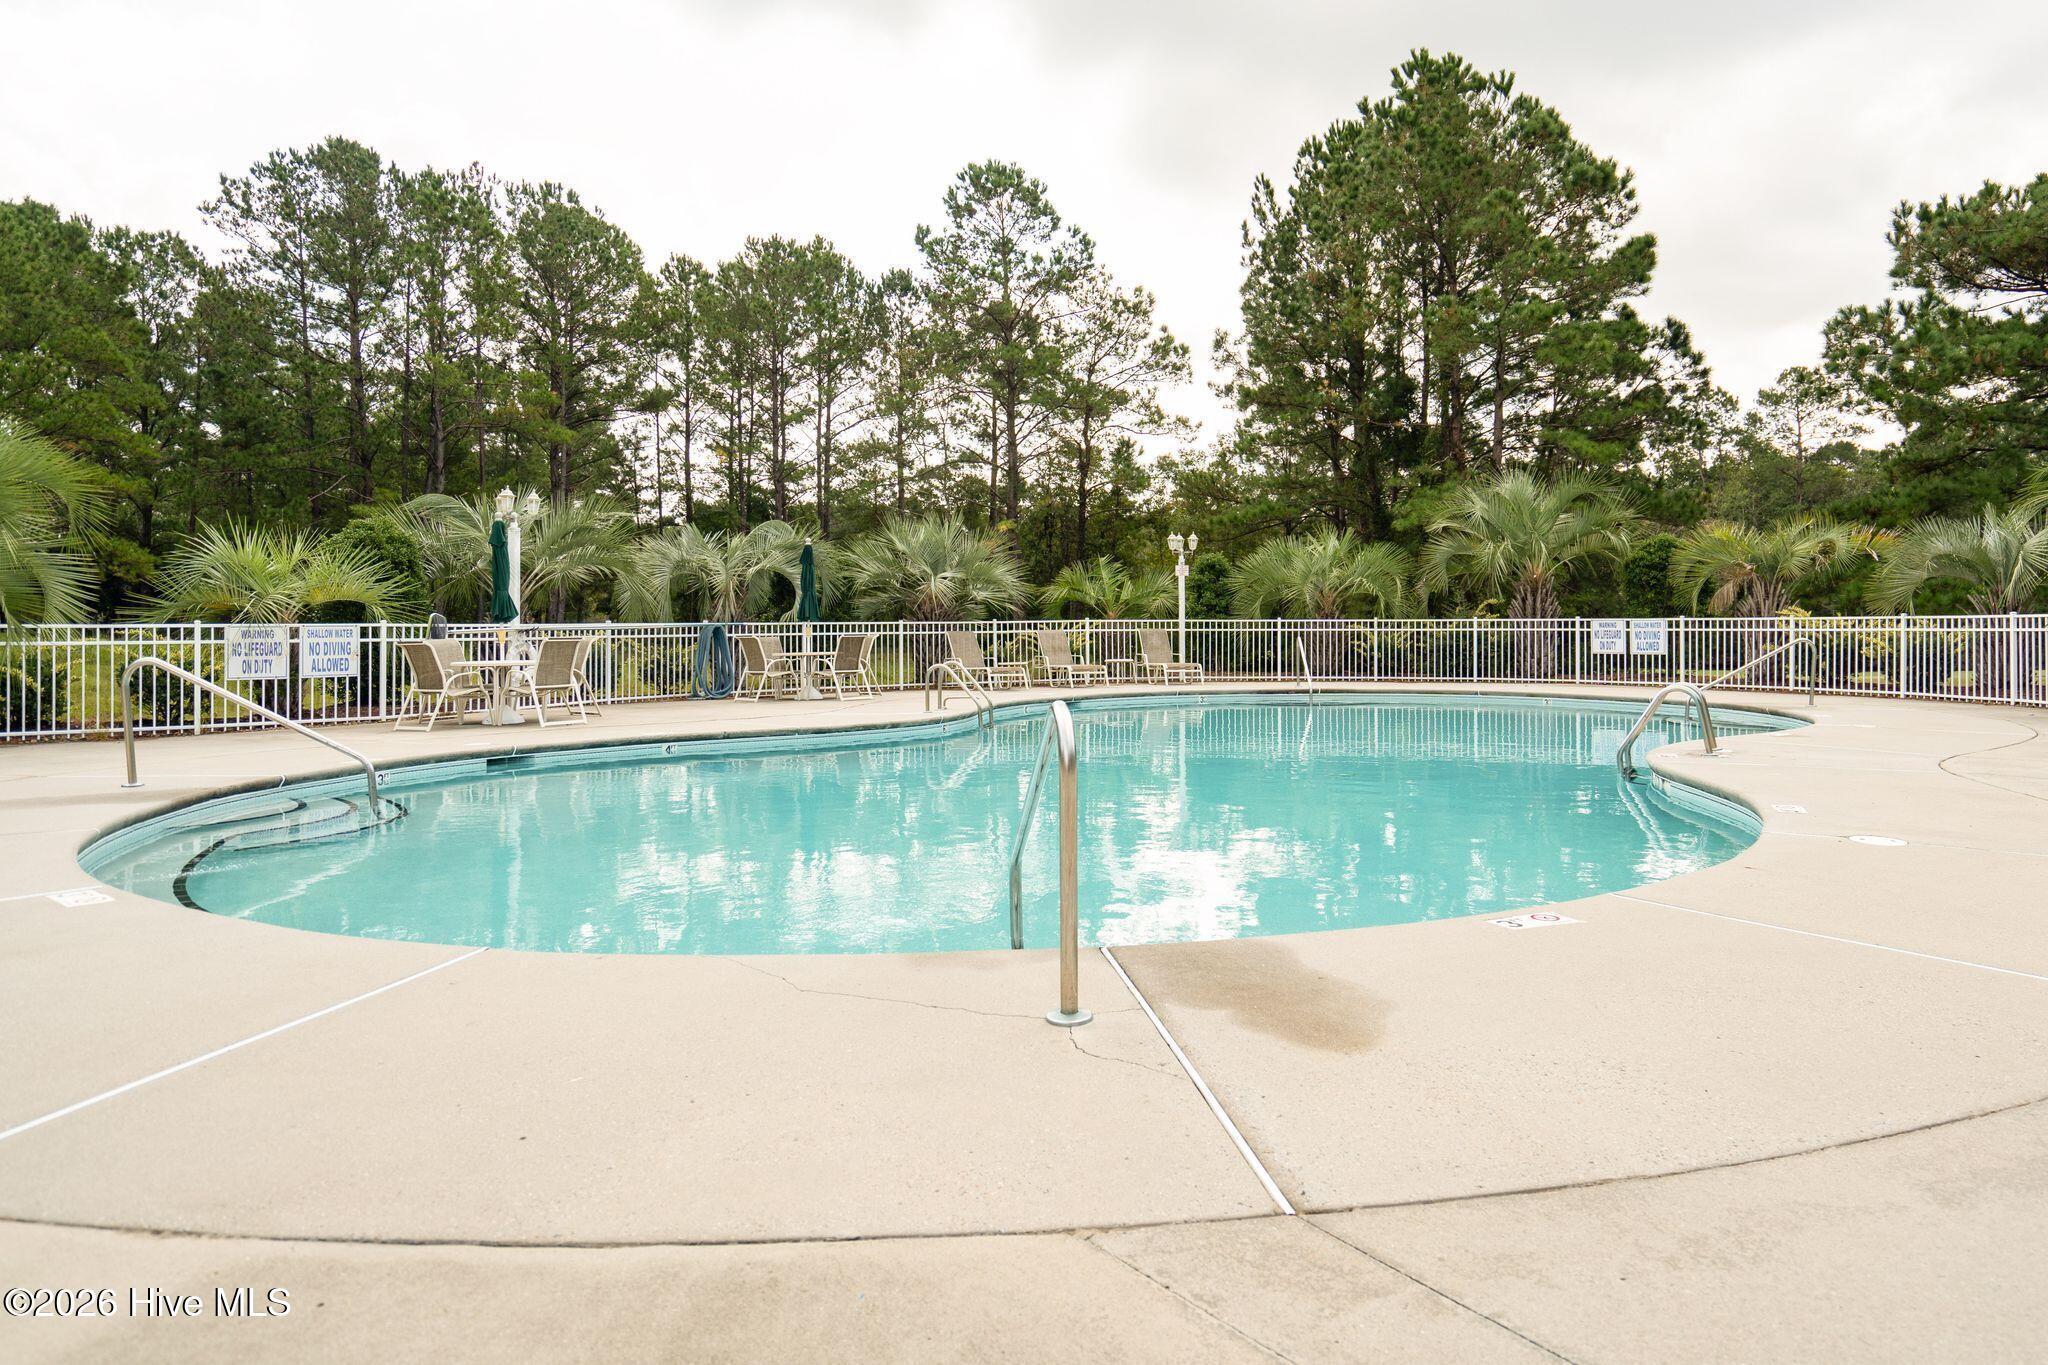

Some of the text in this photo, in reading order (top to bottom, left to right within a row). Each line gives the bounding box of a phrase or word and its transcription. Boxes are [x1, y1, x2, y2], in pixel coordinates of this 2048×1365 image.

[241, 629, 275, 640] WARNING
[307, 628, 354, 639] SHALLOW WATER
[1594, 629, 1600, 639] NO
[1635, 630, 1661, 640] NO DIVING
[231, 642, 283, 656] NO LIFEGUARD
[309, 641, 352, 656] NO DIVING
[1637, 641, 1660, 651] ALLOWED
[242, 659, 252, 674] ON
[311, 658, 350, 672] ALLOWED
[377, 774, 384, 786] 3
